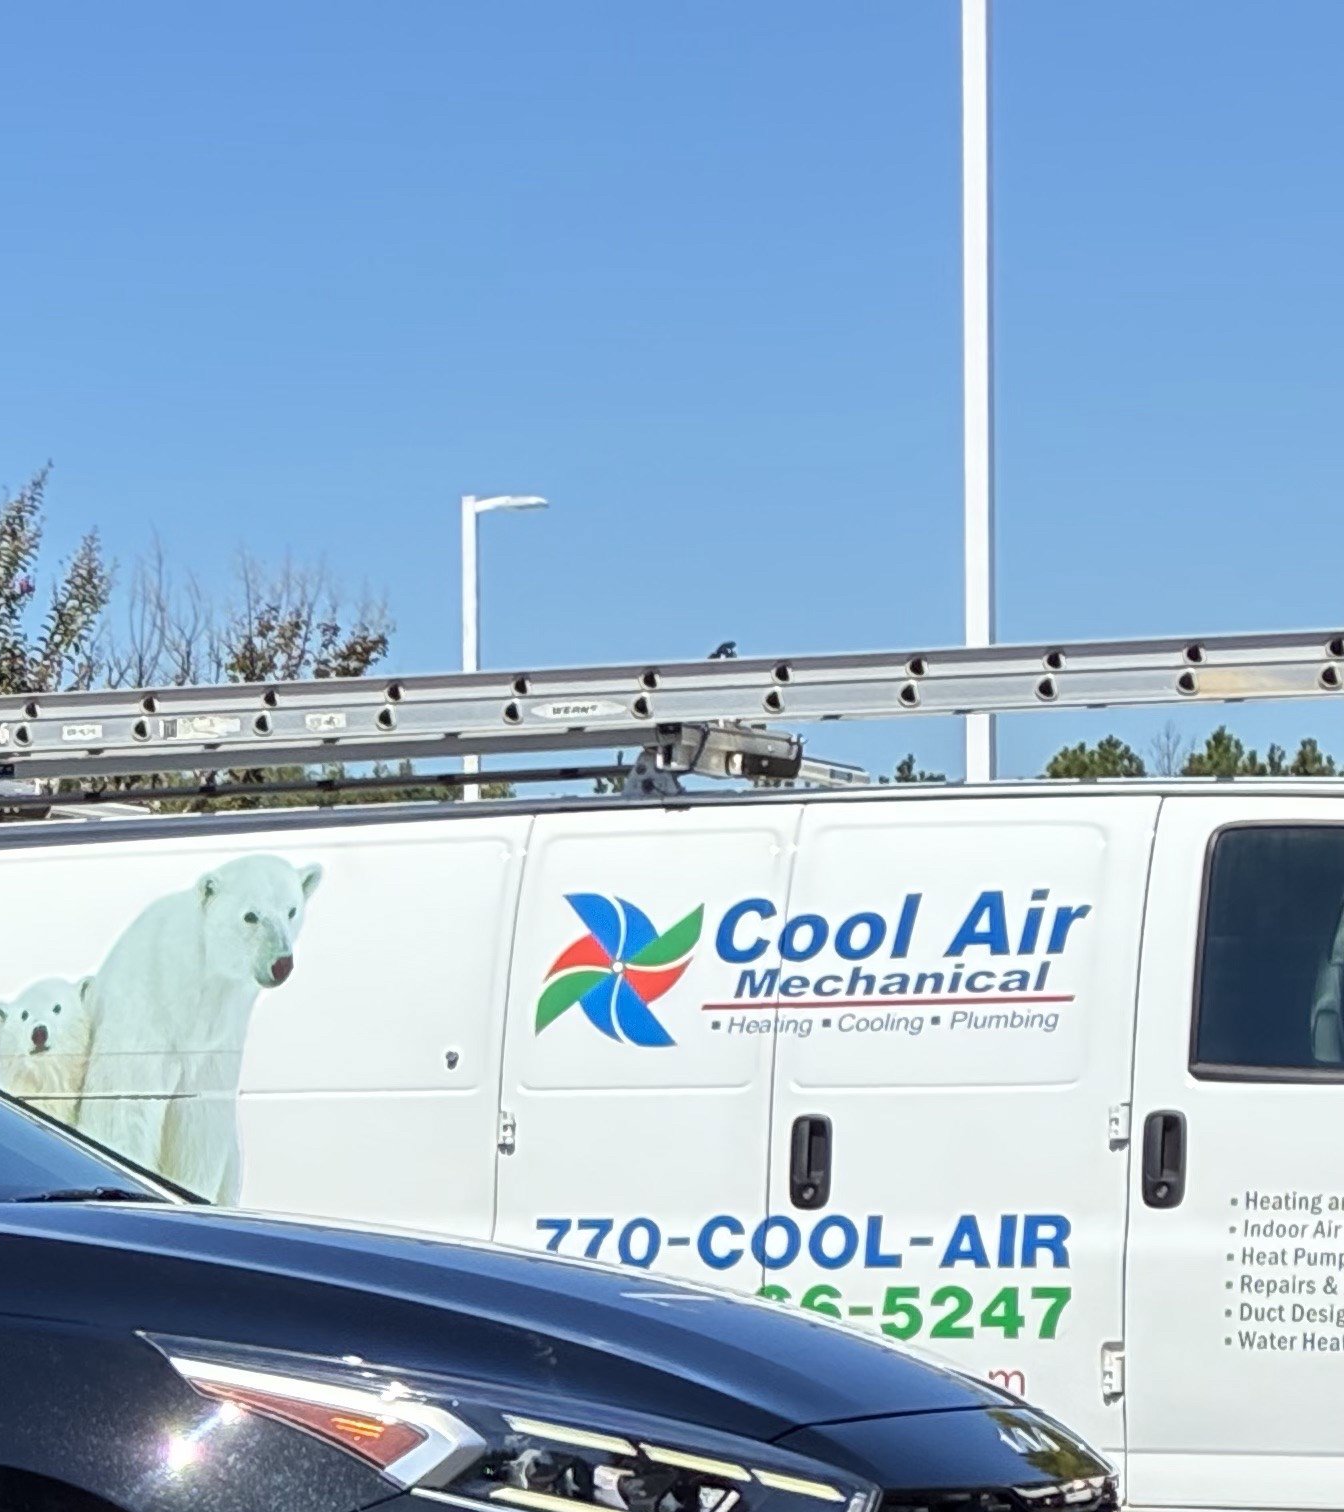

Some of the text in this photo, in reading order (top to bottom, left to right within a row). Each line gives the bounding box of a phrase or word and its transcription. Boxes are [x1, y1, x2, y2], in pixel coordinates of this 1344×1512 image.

[715, 888, 1092, 964] Cool Air
[734, 960, 1052, 999] Mechanical
[727, 1010, 1059, 1038] Heating Cooling Plumbing
[1245, 1191, 1323, 1215] Heating
[1243, 1219, 1343, 1239] Indoor Air
[536, 1214, 1072, 1270] 770-COOL-AIR
[1241, 1246, 1288, 1266] Heat
[1240, 1275, 1338, 1298] Repairs &
[1239, 1303, 1286, 1322] Duct
[1238, 1331, 1344, 1352] Water Hea
